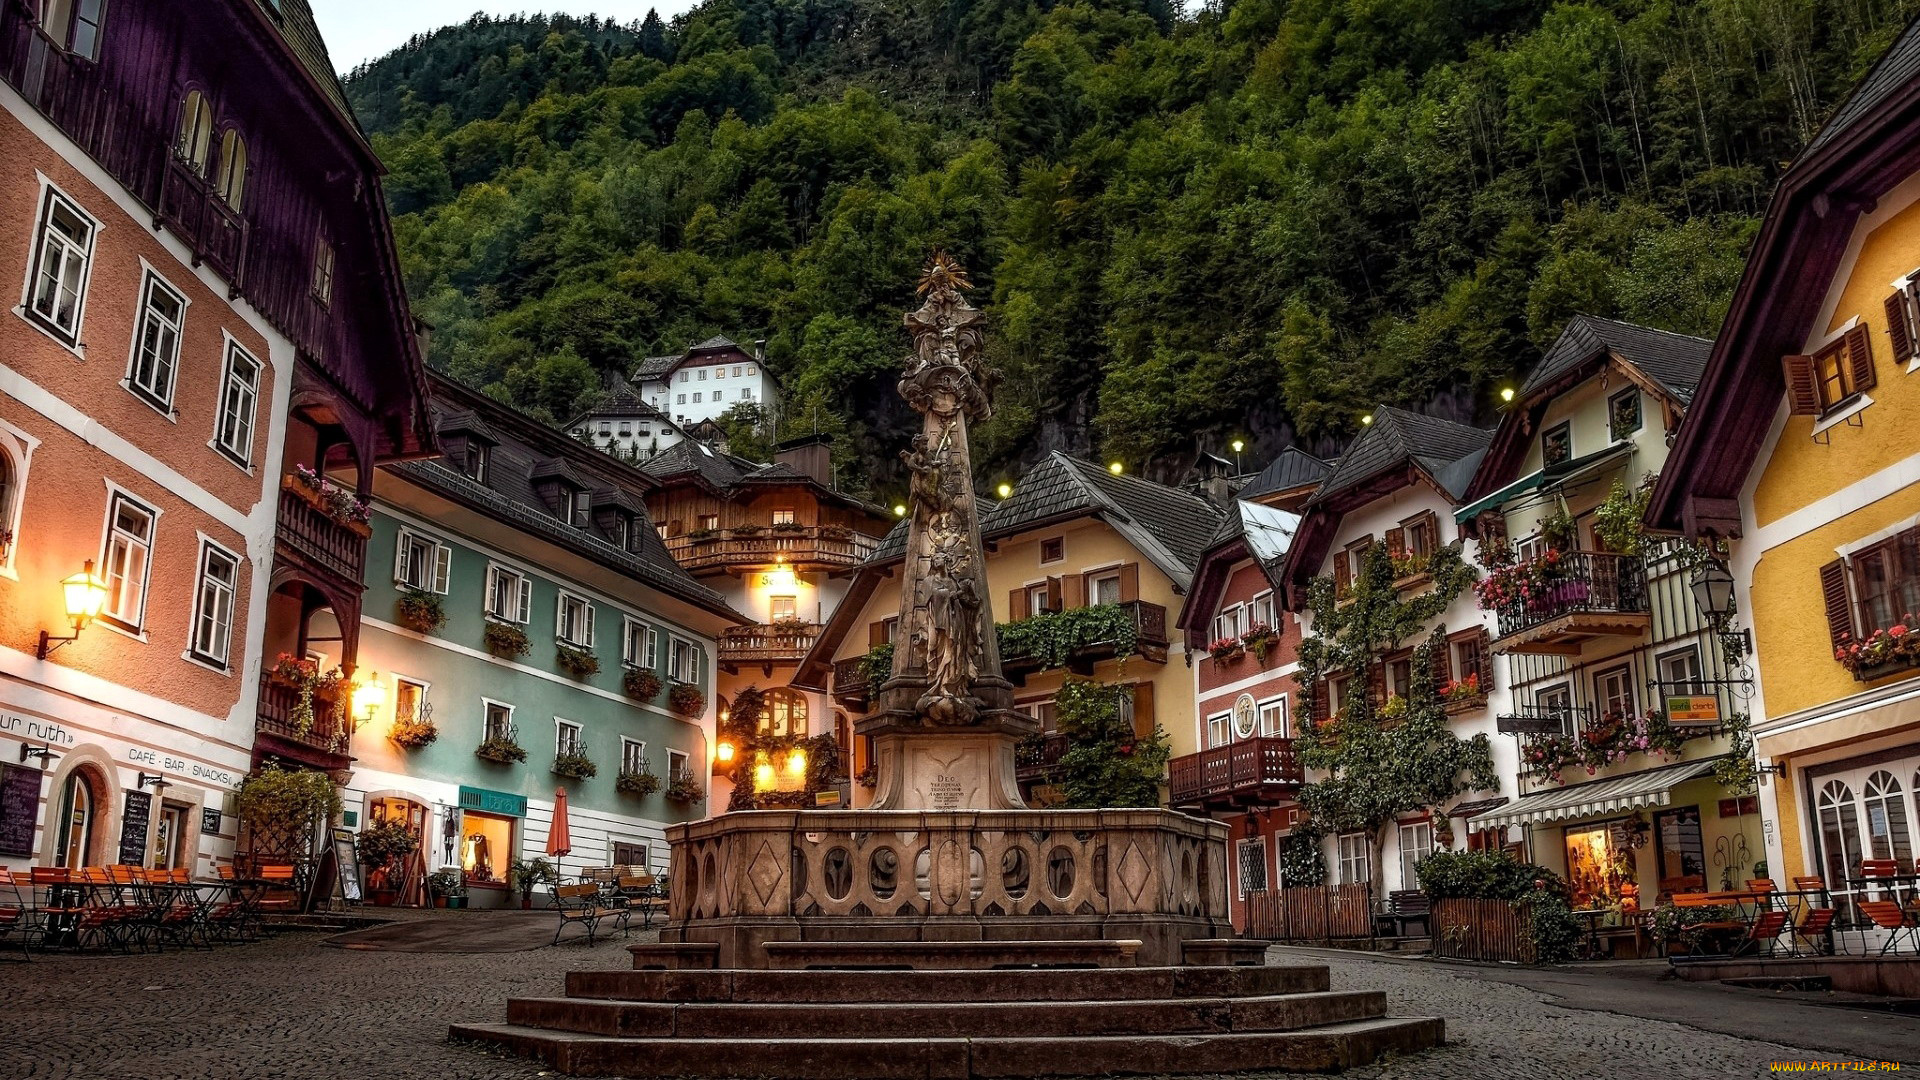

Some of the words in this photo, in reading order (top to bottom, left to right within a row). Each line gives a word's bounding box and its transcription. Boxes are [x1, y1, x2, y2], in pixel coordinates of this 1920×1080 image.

[128, 748, 156, 765] CAFÉ
[164, 757, 185, 772] BAR
[192, 765, 229, 784] SNACKS
